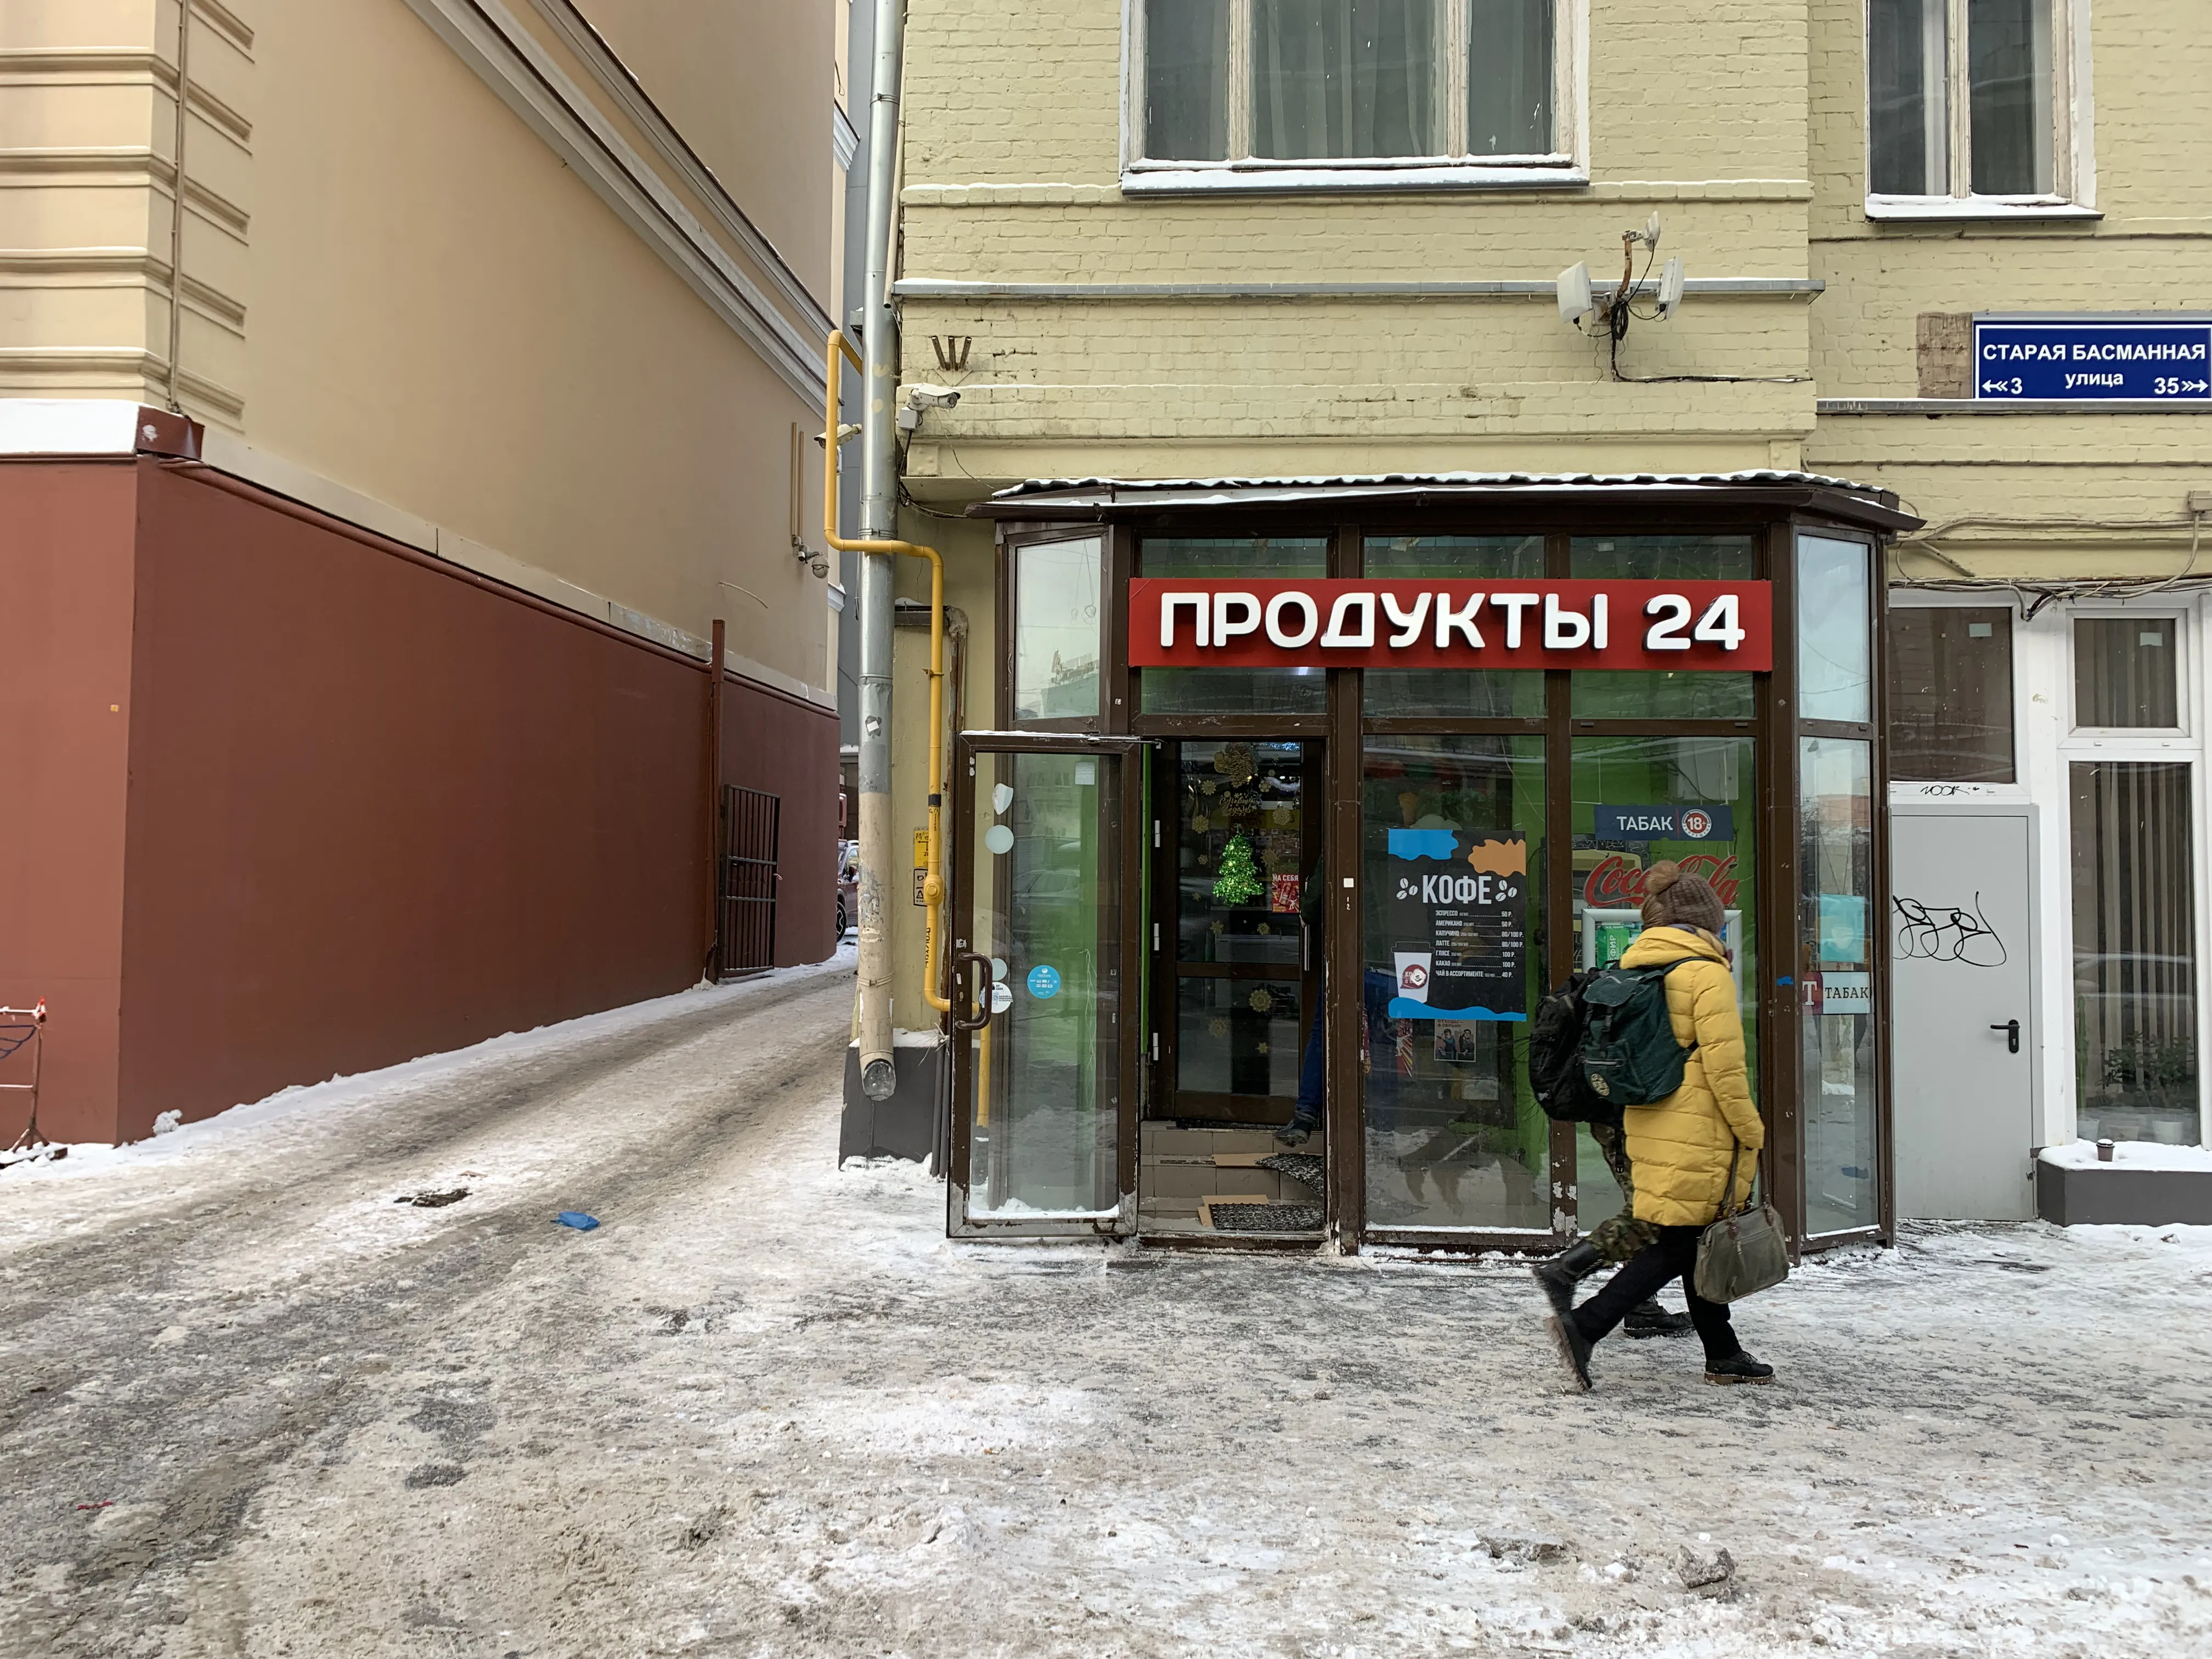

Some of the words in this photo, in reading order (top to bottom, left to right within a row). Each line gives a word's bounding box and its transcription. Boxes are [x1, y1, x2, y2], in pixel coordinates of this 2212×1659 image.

[1983, 344, 2066, 360] СТАРАЯ
[2073, 344, 2206, 360] БАСМАННАЯ
[2011, 377, 2023, 394] 3
[2065, 373, 2124, 389] улица
[2154, 377, 2180, 394] 35
[1160, 591, 1610, 650] ПРОДУКТЫ
[1645, 594, 1747, 651] 24
[1616, 816, 1673, 831] ТАБАК
[1687, 816, 1707, 831] 18+
[1422, 874, 1492, 905] КОФЕ
[1825, 987, 1869, 999] ТАБАК
